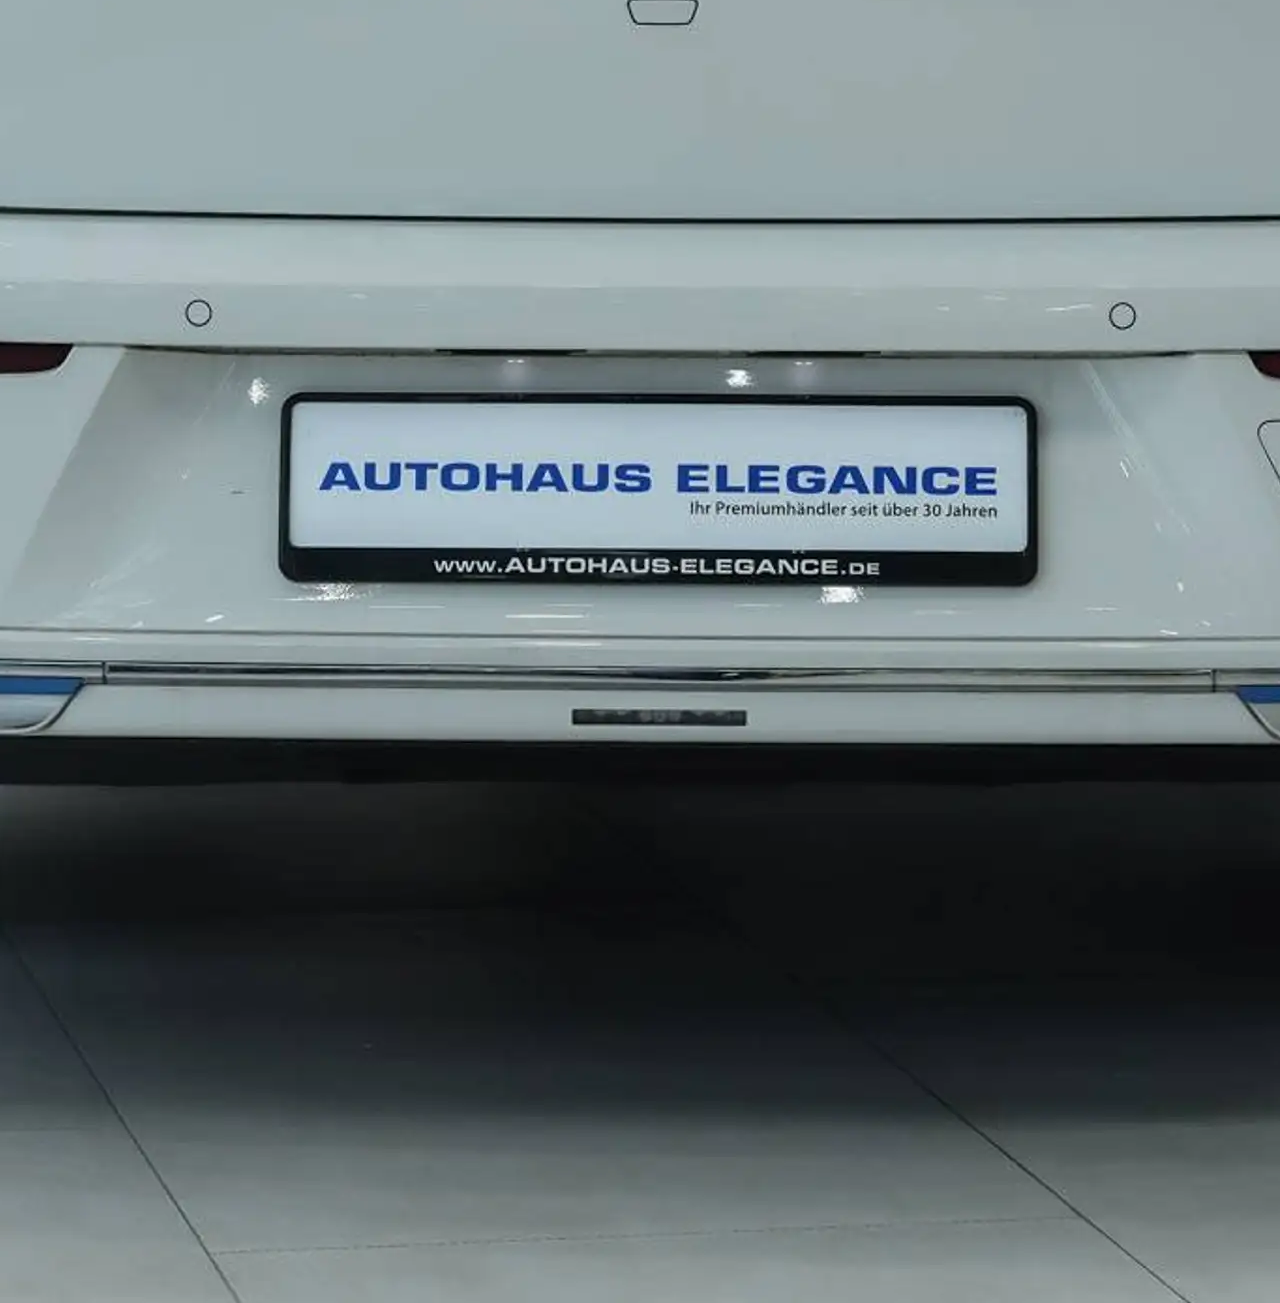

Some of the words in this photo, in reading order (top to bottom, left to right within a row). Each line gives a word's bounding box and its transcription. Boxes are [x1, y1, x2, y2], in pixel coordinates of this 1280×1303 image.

[319, 462, 652, 493] AUTOHAUS
[677, 465, 998, 496] ELEGANCE
[689, 501, 711, 516] Ihr
[715, 501, 847, 518] Premiumhändler
[851, 503, 878, 517] seit
[882, 502, 918, 518] über
[922, 504, 942, 518] 30
[945, 504, 998, 519] Jahren
